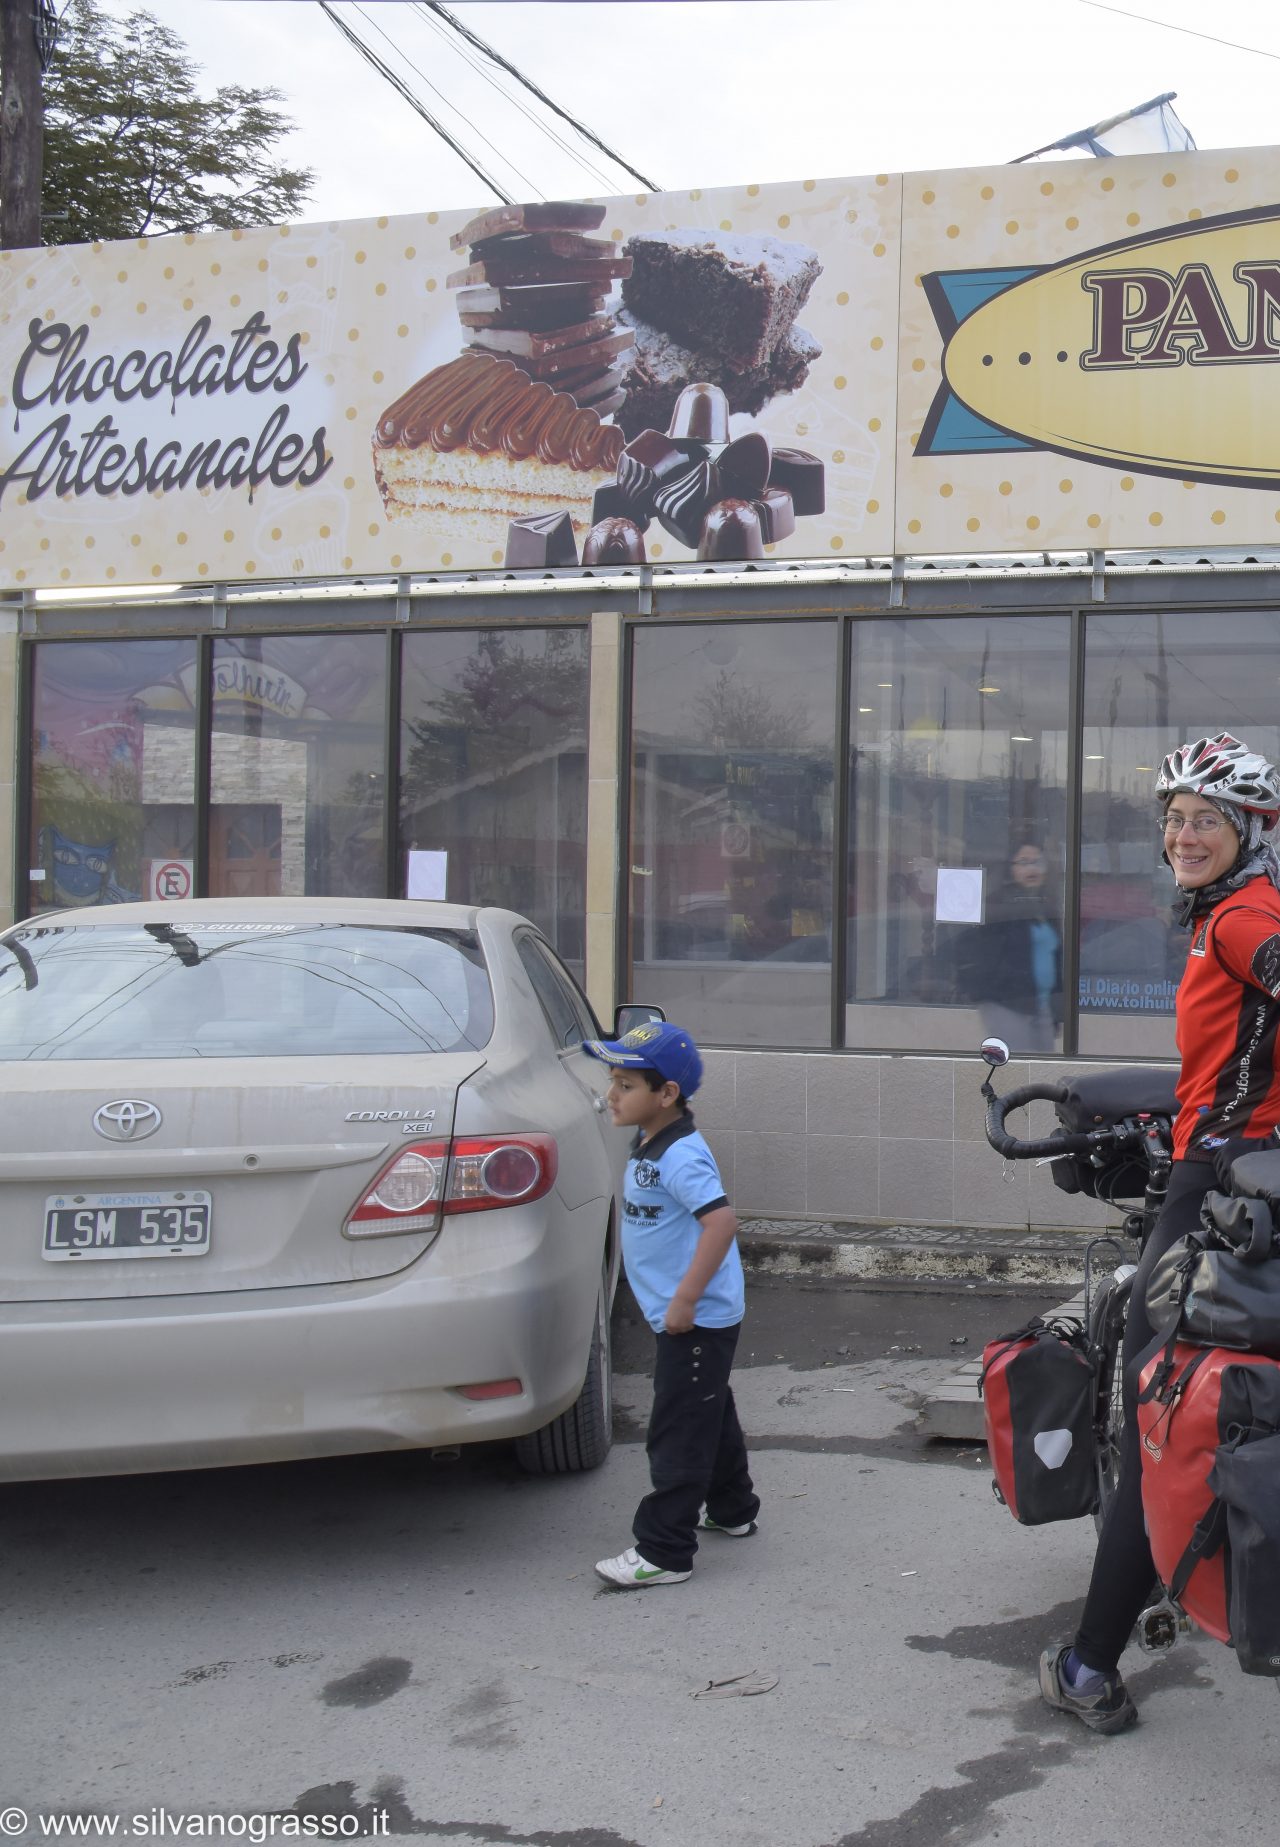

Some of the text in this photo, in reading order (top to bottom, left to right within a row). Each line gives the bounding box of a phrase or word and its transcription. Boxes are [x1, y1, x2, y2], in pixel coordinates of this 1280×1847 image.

[12, 310, 309, 414] Chocolates
[0, 404, 334, 505] Artesanales
[1097, 979, 1139, 994] Diario
[344, 1109, 435, 1122] COROLLA
[98, 1196, 162, 1206] ARGENTINA
[50, 1207, 204, 1248] LSM 535
